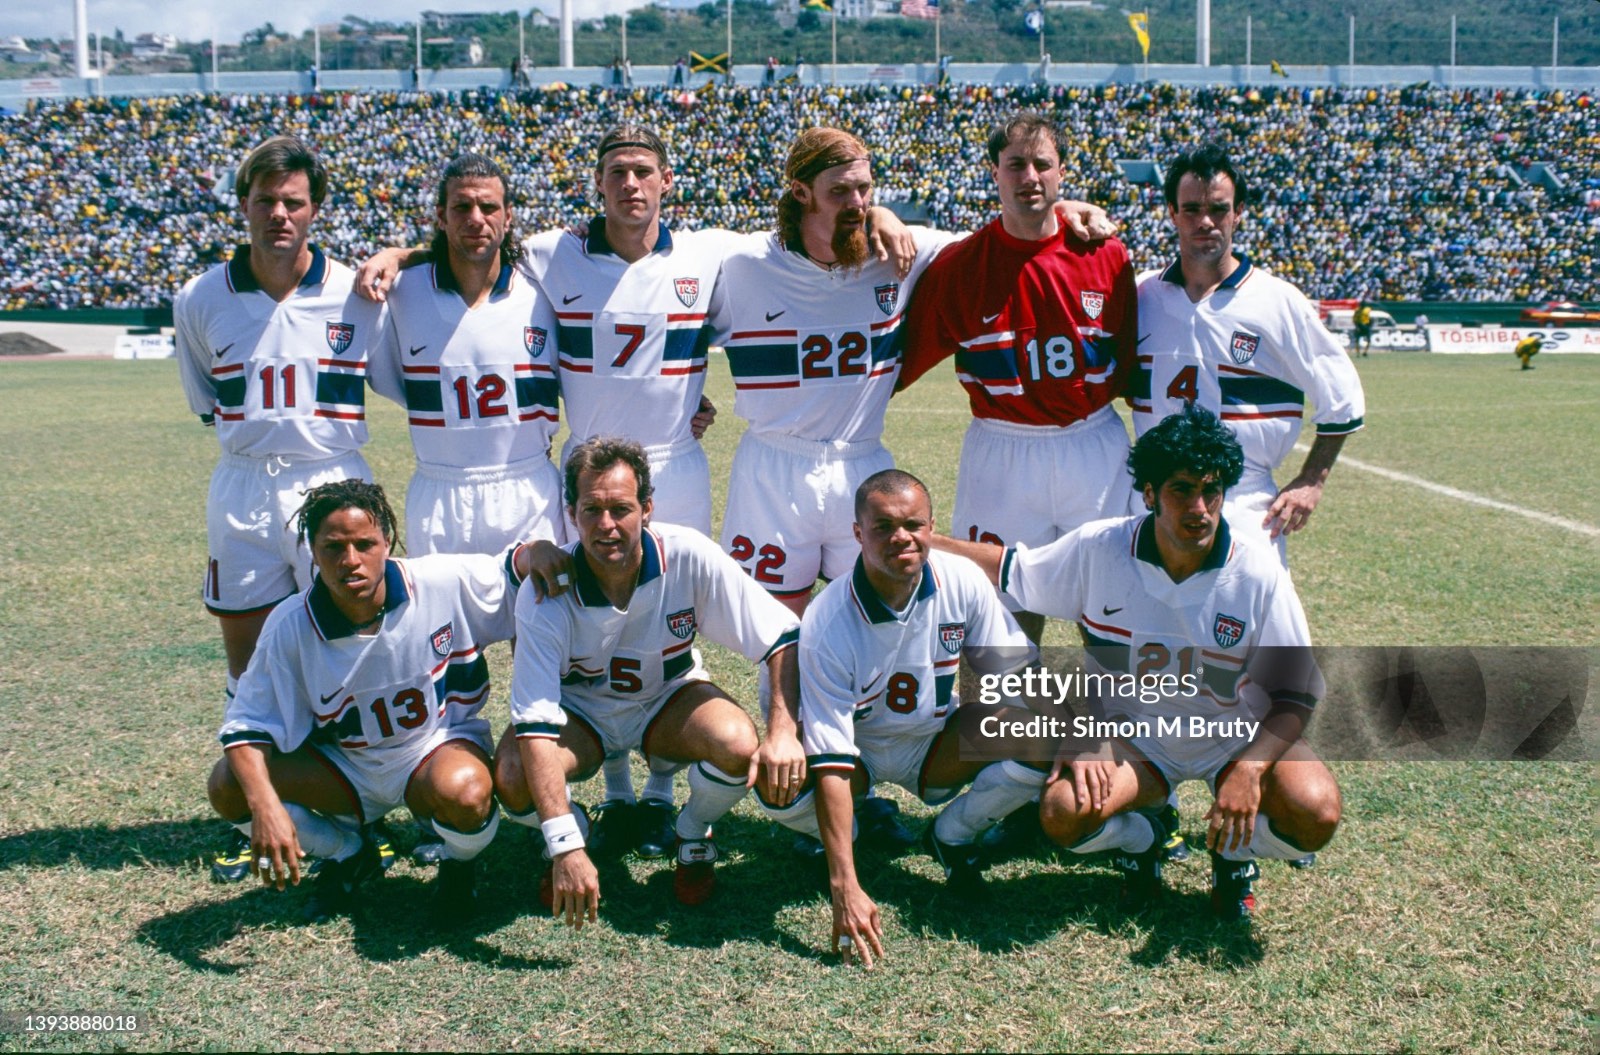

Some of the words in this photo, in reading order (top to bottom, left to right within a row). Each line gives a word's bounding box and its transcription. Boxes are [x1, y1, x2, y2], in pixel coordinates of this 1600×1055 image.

[611, 323, 646, 368] 7
[800, 331, 868, 380] 22
[1025, 335, 1075, 382] 18
[1440, 331, 1522, 343] TOSHIBA
[259, 363, 296, 410] 11
[453, 373, 509, 420] 12
[1166, 365, 1200, 404] 4
[729, 534, 787, 585] 22
[609, 656, 643, 693] 5
[1137, 642, 1195, 691] 21
[369, 687, 429, 738] 13
[886, 671, 919, 714] 8
